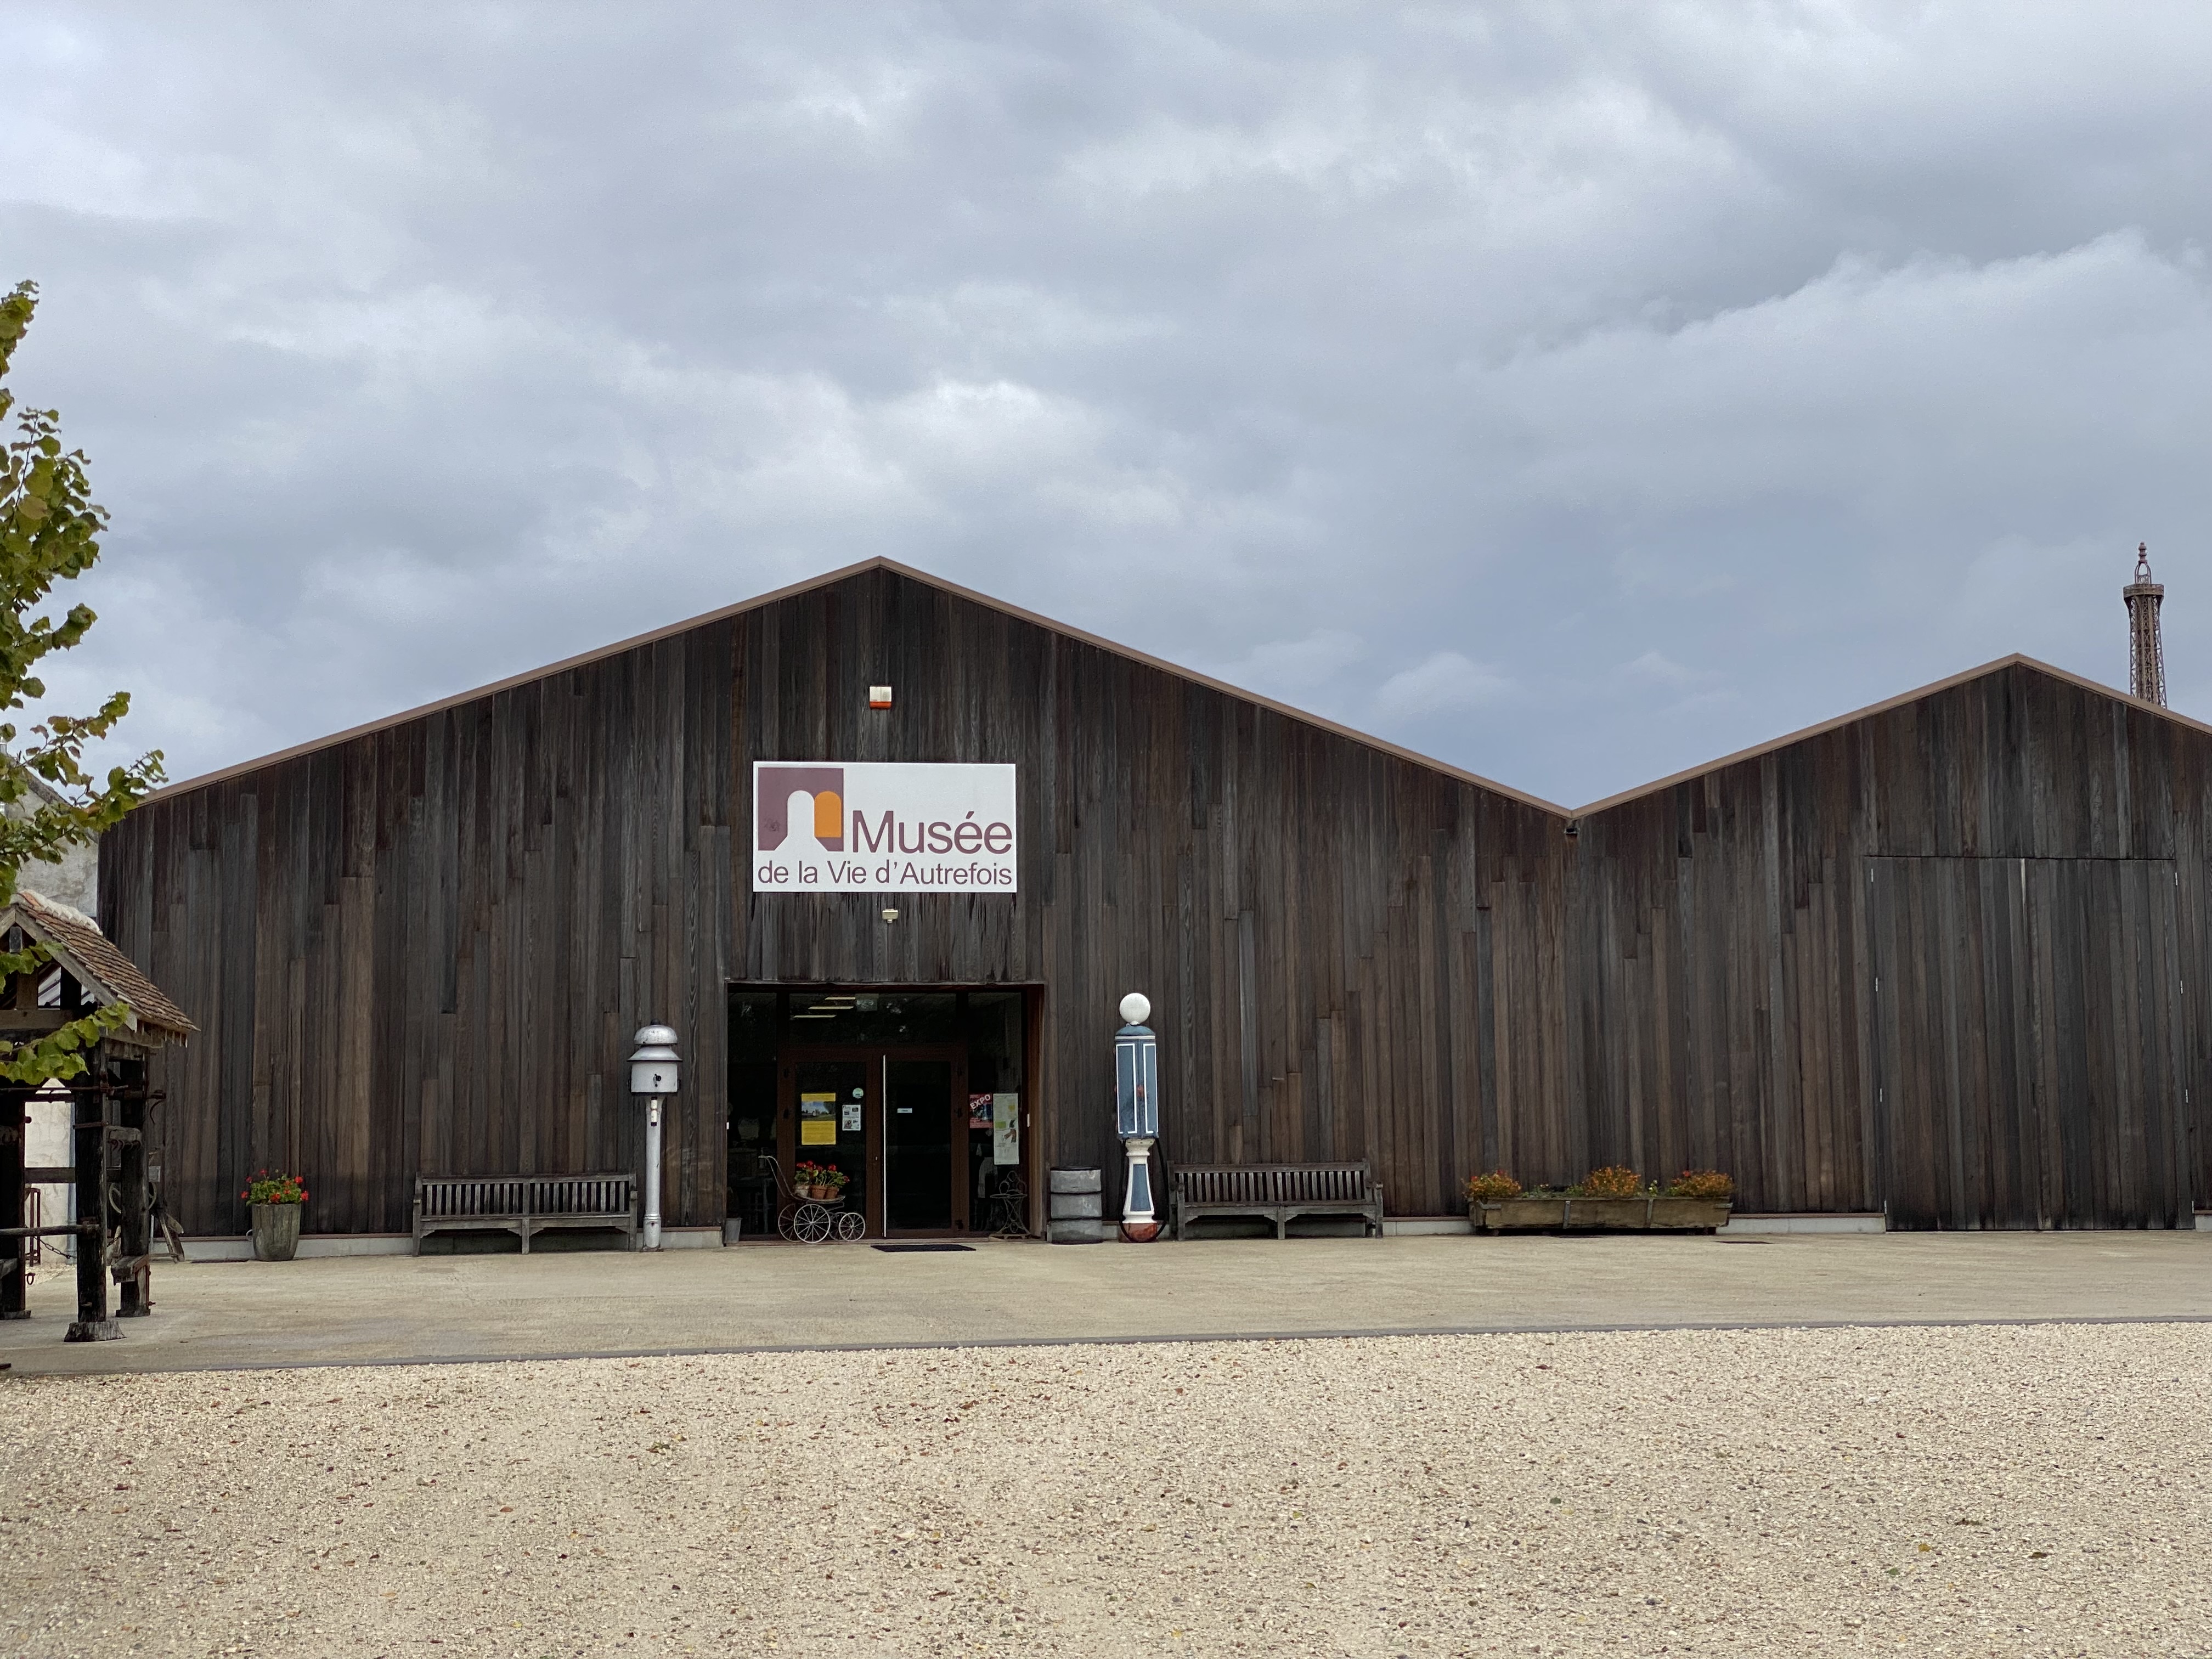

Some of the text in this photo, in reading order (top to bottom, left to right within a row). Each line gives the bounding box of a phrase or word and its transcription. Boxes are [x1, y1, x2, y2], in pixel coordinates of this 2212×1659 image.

[853, 810, 1012, 854] Musée
[758, 859, 1012, 885] de la Vie d'Autrefois
[969, 1094, 991, 1109] EXPO
